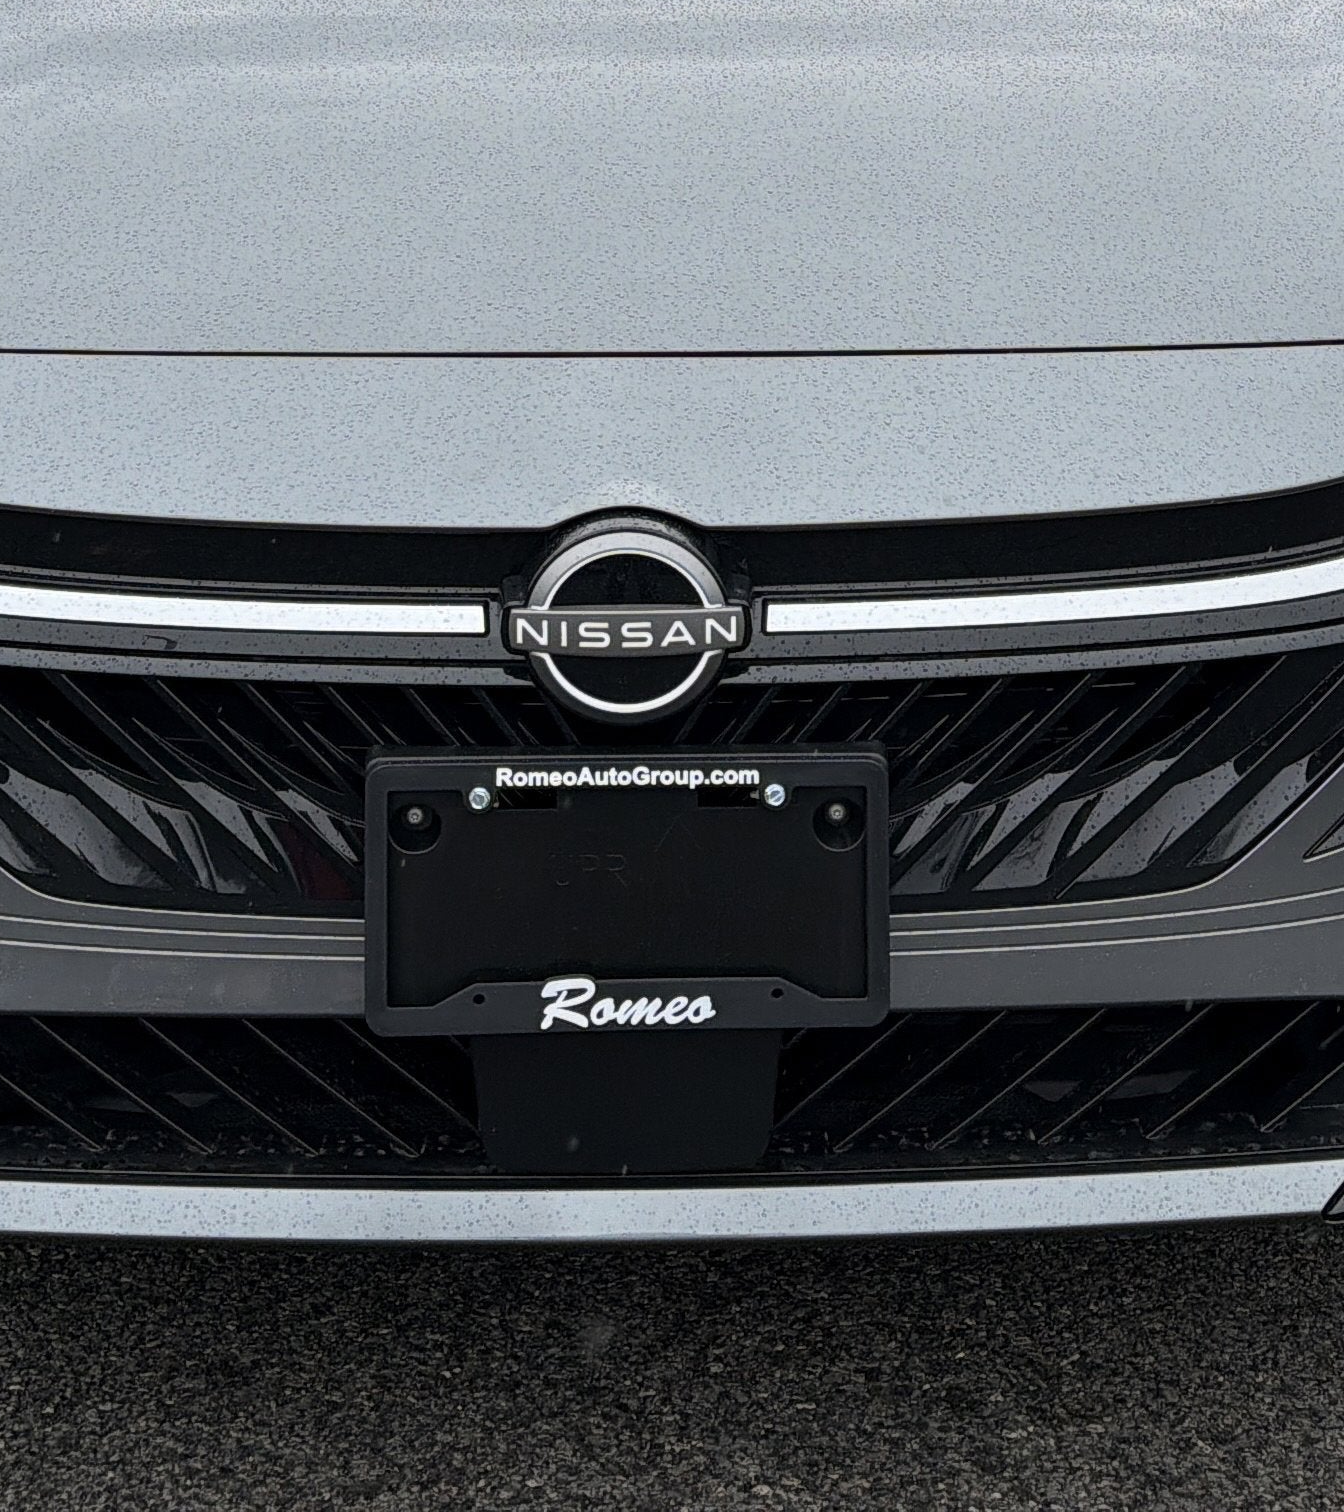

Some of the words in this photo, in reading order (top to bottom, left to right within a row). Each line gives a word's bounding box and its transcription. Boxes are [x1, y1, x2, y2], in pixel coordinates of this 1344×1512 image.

[516, 615, 737, 648] NISSAN
[495, 766, 760, 789] RomeoAutoGroup.com
[540, 978, 717, 1030] Romeo
